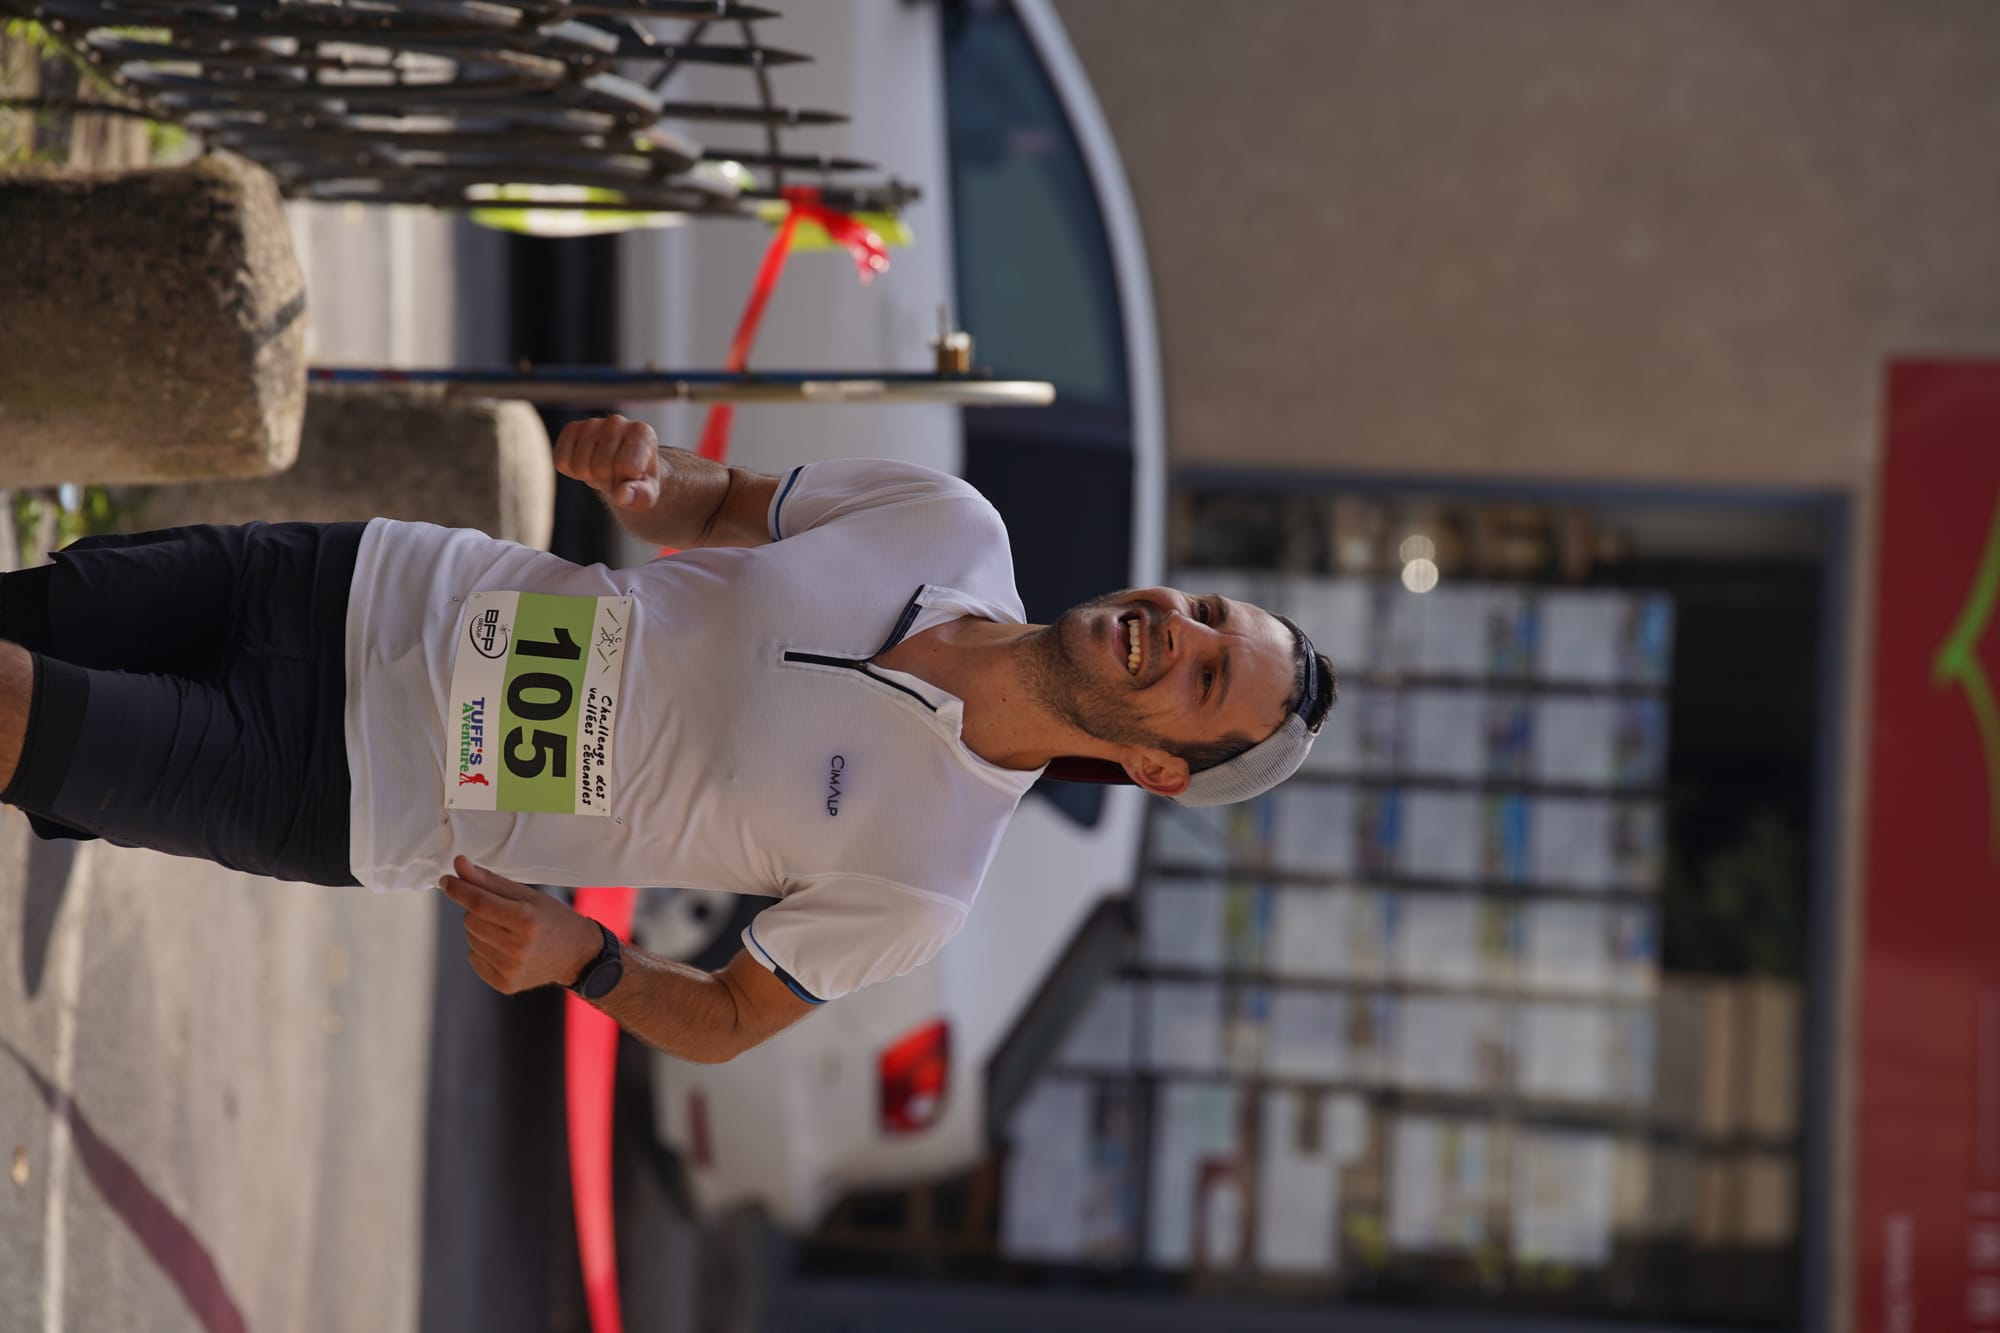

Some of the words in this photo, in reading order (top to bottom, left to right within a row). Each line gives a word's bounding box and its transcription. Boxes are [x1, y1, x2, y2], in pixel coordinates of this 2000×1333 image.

[476, 617, 484, 639] GROUP
[480, 609, 500, 651] BFP
[469, 697, 486, 766] TUFF'S
[504, 627, 582, 779] 105
[584, 687, 597, 736] vallées
[593, 695, 613, 767] Challenge
[460, 703, 475, 772] Aventure
[582, 744, 595, 806] cévenoles
[596, 775, 607, 800] des
[827, 755, 845, 816] CIMALP
